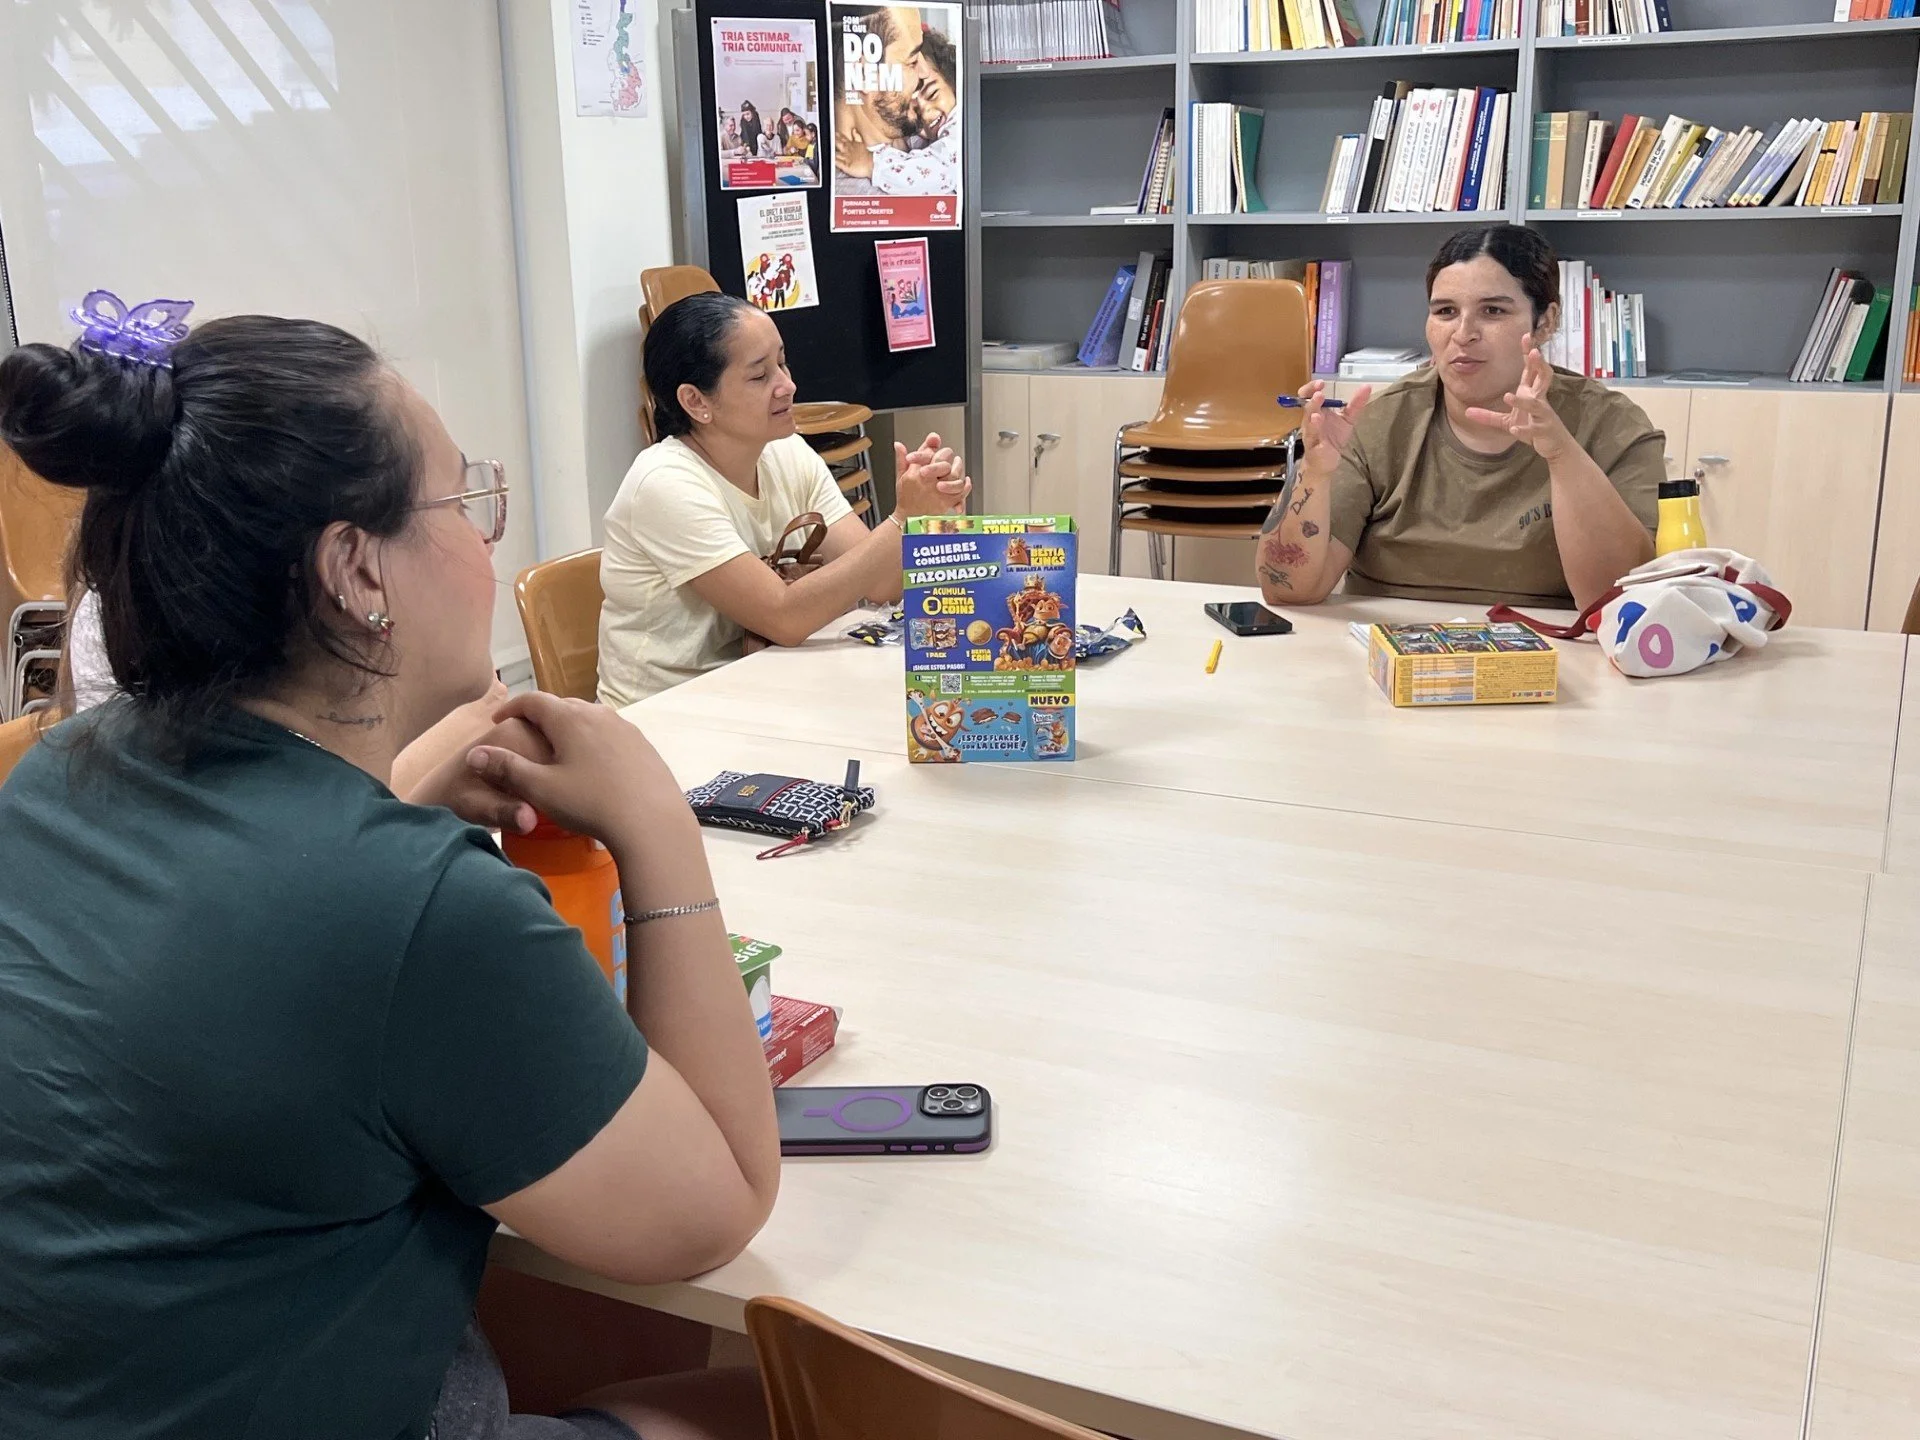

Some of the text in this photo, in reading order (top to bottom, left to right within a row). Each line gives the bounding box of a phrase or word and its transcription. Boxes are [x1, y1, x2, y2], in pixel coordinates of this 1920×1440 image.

[843, 16, 860, 24] SOM
[721, 31, 744, 41] TRIA
[722, 42, 745, 52] TRIA
[843, 32, 883, 64] DO
[844, 63, 903, 91] NEM
[912, 541, 978, 558] ¿QUIERES
[1030, 547, 1066, 557] BESTIA
[915, 554, 971, 567] CONSEGUIR
[1030, 556, 1066, 567] KINGS
[933, 587, 966, 596] ACUMULA
[941, 596, 974, 606] BESTIA
[941, 605, 975, 615] COINS
[971, 654, 992, 662] COIN
[1030, 695, 1071, 706] NUEVO
[989, 734, 1021, 742] FLAKES
[976, 742, 989, 751] LA
[989, 740, 1028, 752] LECHE!
